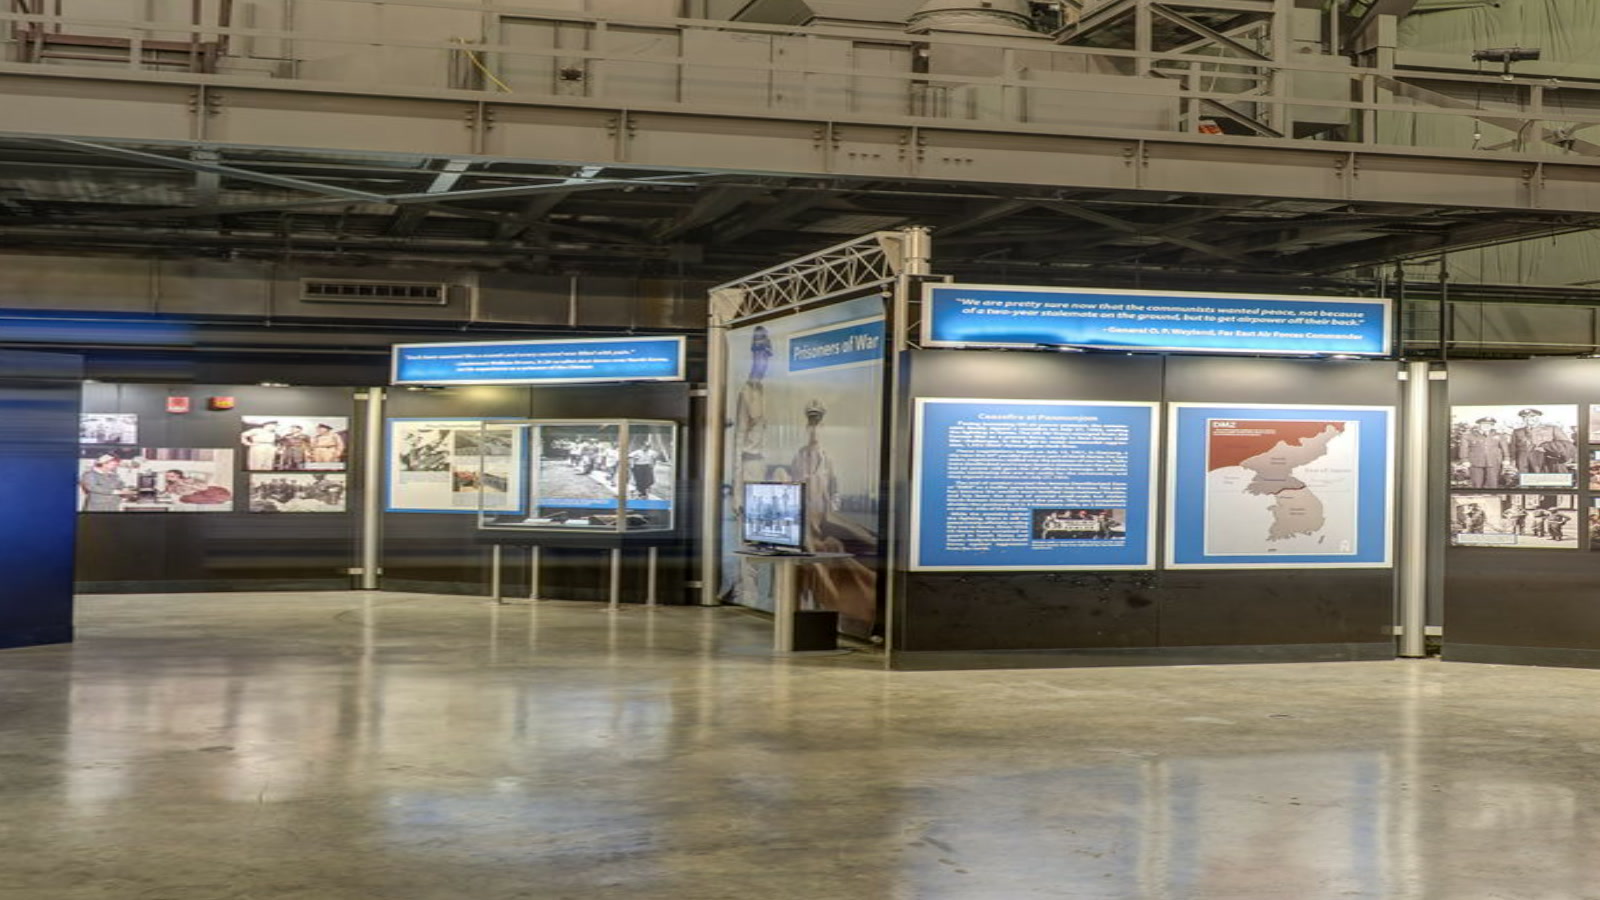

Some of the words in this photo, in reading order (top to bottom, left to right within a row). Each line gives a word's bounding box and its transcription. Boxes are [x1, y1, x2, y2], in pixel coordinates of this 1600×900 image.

[986, 309, 1039, 317] two-year
[1040, 310, 1098, 318] stalemate
[1137, 313, 1181, 321] ground,
[1236, 316, 1287, 324] airpower
[1004, 301, 1043, 309] pretty
[1319, 310, 1364, 318] because
[793, 340, 839, 361] Prisoners
[840, 335, 854, 353] of
[854, 334, 879, 351] War
[977, 412, 1024, 420] Ceasefire
[1212, 420, 1237, 428] DMZ
